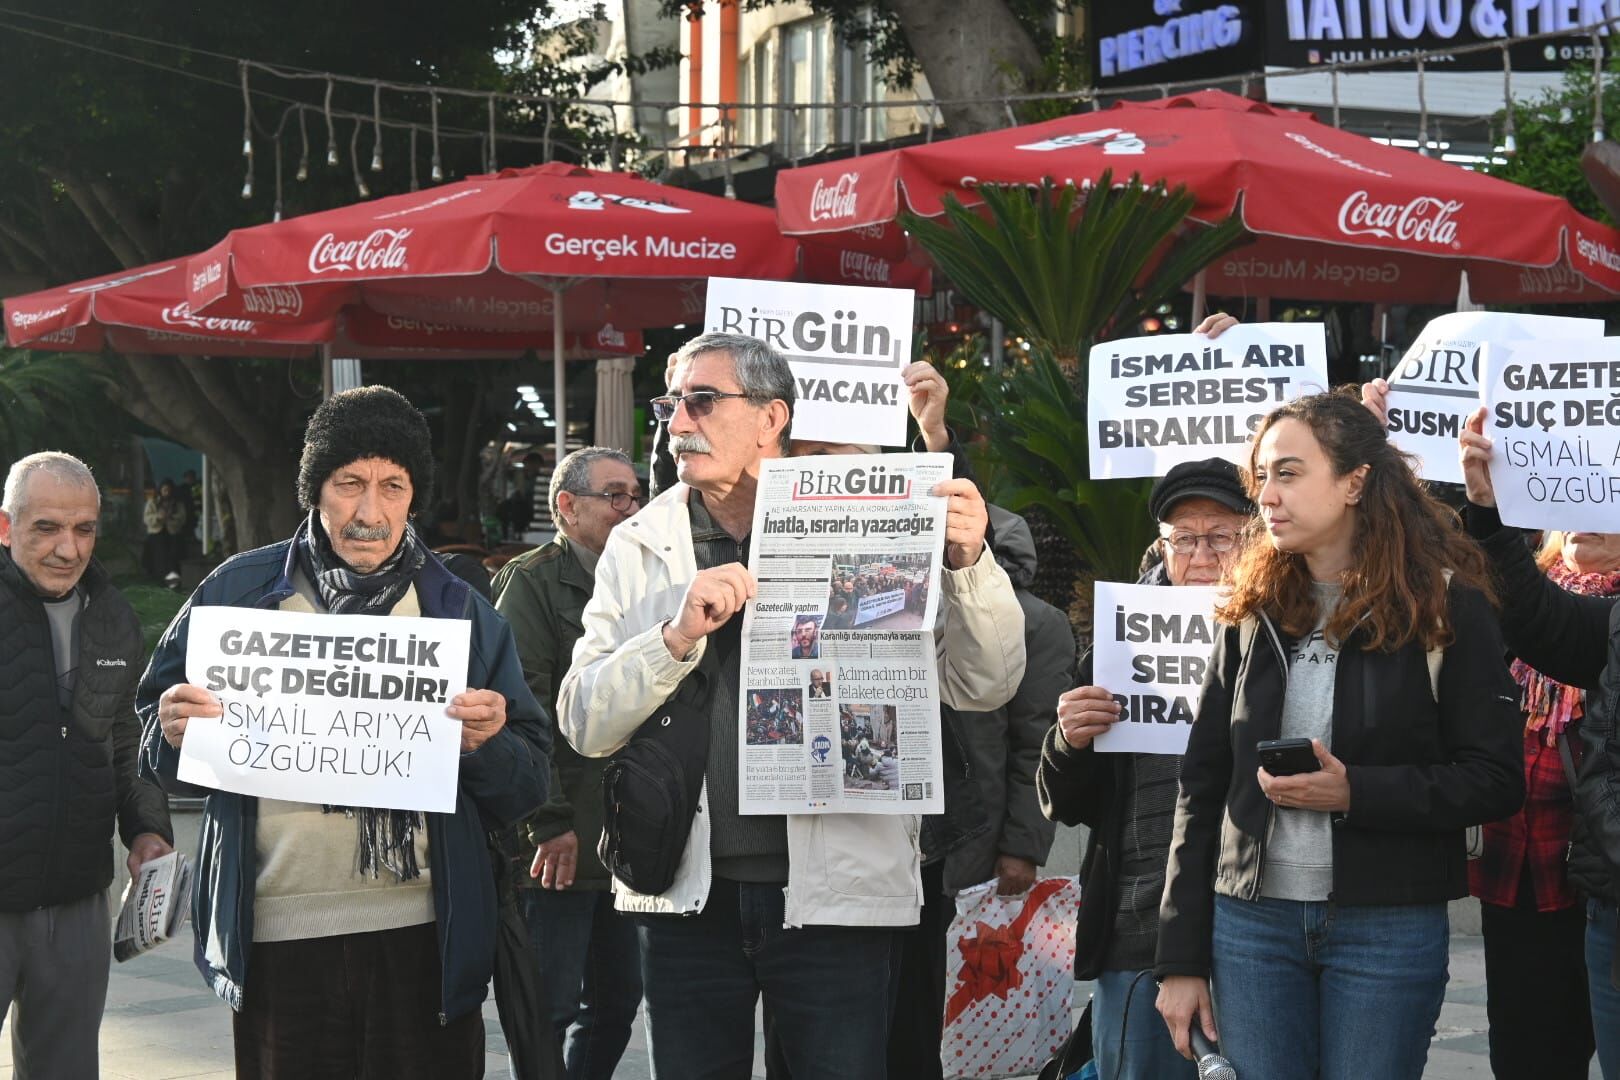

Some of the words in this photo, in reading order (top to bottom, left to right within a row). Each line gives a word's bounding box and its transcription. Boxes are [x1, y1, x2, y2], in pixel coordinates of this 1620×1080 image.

[1286, 0, 1462, 40] TATTOO
[1469, 0, 1508, 38] &
[1511, 0, 1620, 38] PIER
[1100, 4, 1242, 77] PIERCING
[1338, 190, 1464, 245] Coca-Cola
[309, 228, 413, 274] Coca-Cola
[545, 232, 637, 262] Gerçek
[645, 236, 736, 260] Mucize
[1111, 346, 1233, 379] İSMAİL
[1241, 344, 1305, 368] ARI
[794, 378, 899, 406] YACAK!
[1125, 377, 1290, 408] SERBEST
[1388, 408, 1467, 439] SUSM
[1495, 400, 1556, 433] SUÇ
[1563, 392, 1620, 427] DEĞ
[1504, 435, 1602, 468] İSMAİL
[799, 466, 905, 495] BİRGün
[763, 512, 808, 535] İnatla,
[810, 515, 858, 533] ısrarla
[862, 513, 934, 536] yazacağız
[755, 602, 793, 612] Gazetecilik
[219, 629, 441, 667] GAZETECİLİK
[820, 632, 851, 641] Karanlığı
[852, 632, 899, 642] dayanışmayla
[206, 665, 274, 698] SUÇ
[280, 664, 449, 704] DEĞİLDİR!
[838, 666, 870, 681] Adım
[871, 666, 907, 681] adım
[909, 666, 927, 681] bir
[1131, 654, 1212, 685] SER
[837, 685, 886, 699] felakete
[887, 685, 929, 701] doğru
[219, 697, 316, 736] İSMAİL
[327, 709, 432, 743] ARI'YA
[1114, 694, 1199, 725] BIRA
[228, 733, 412, 778] ÖZGÜRLÜK!
